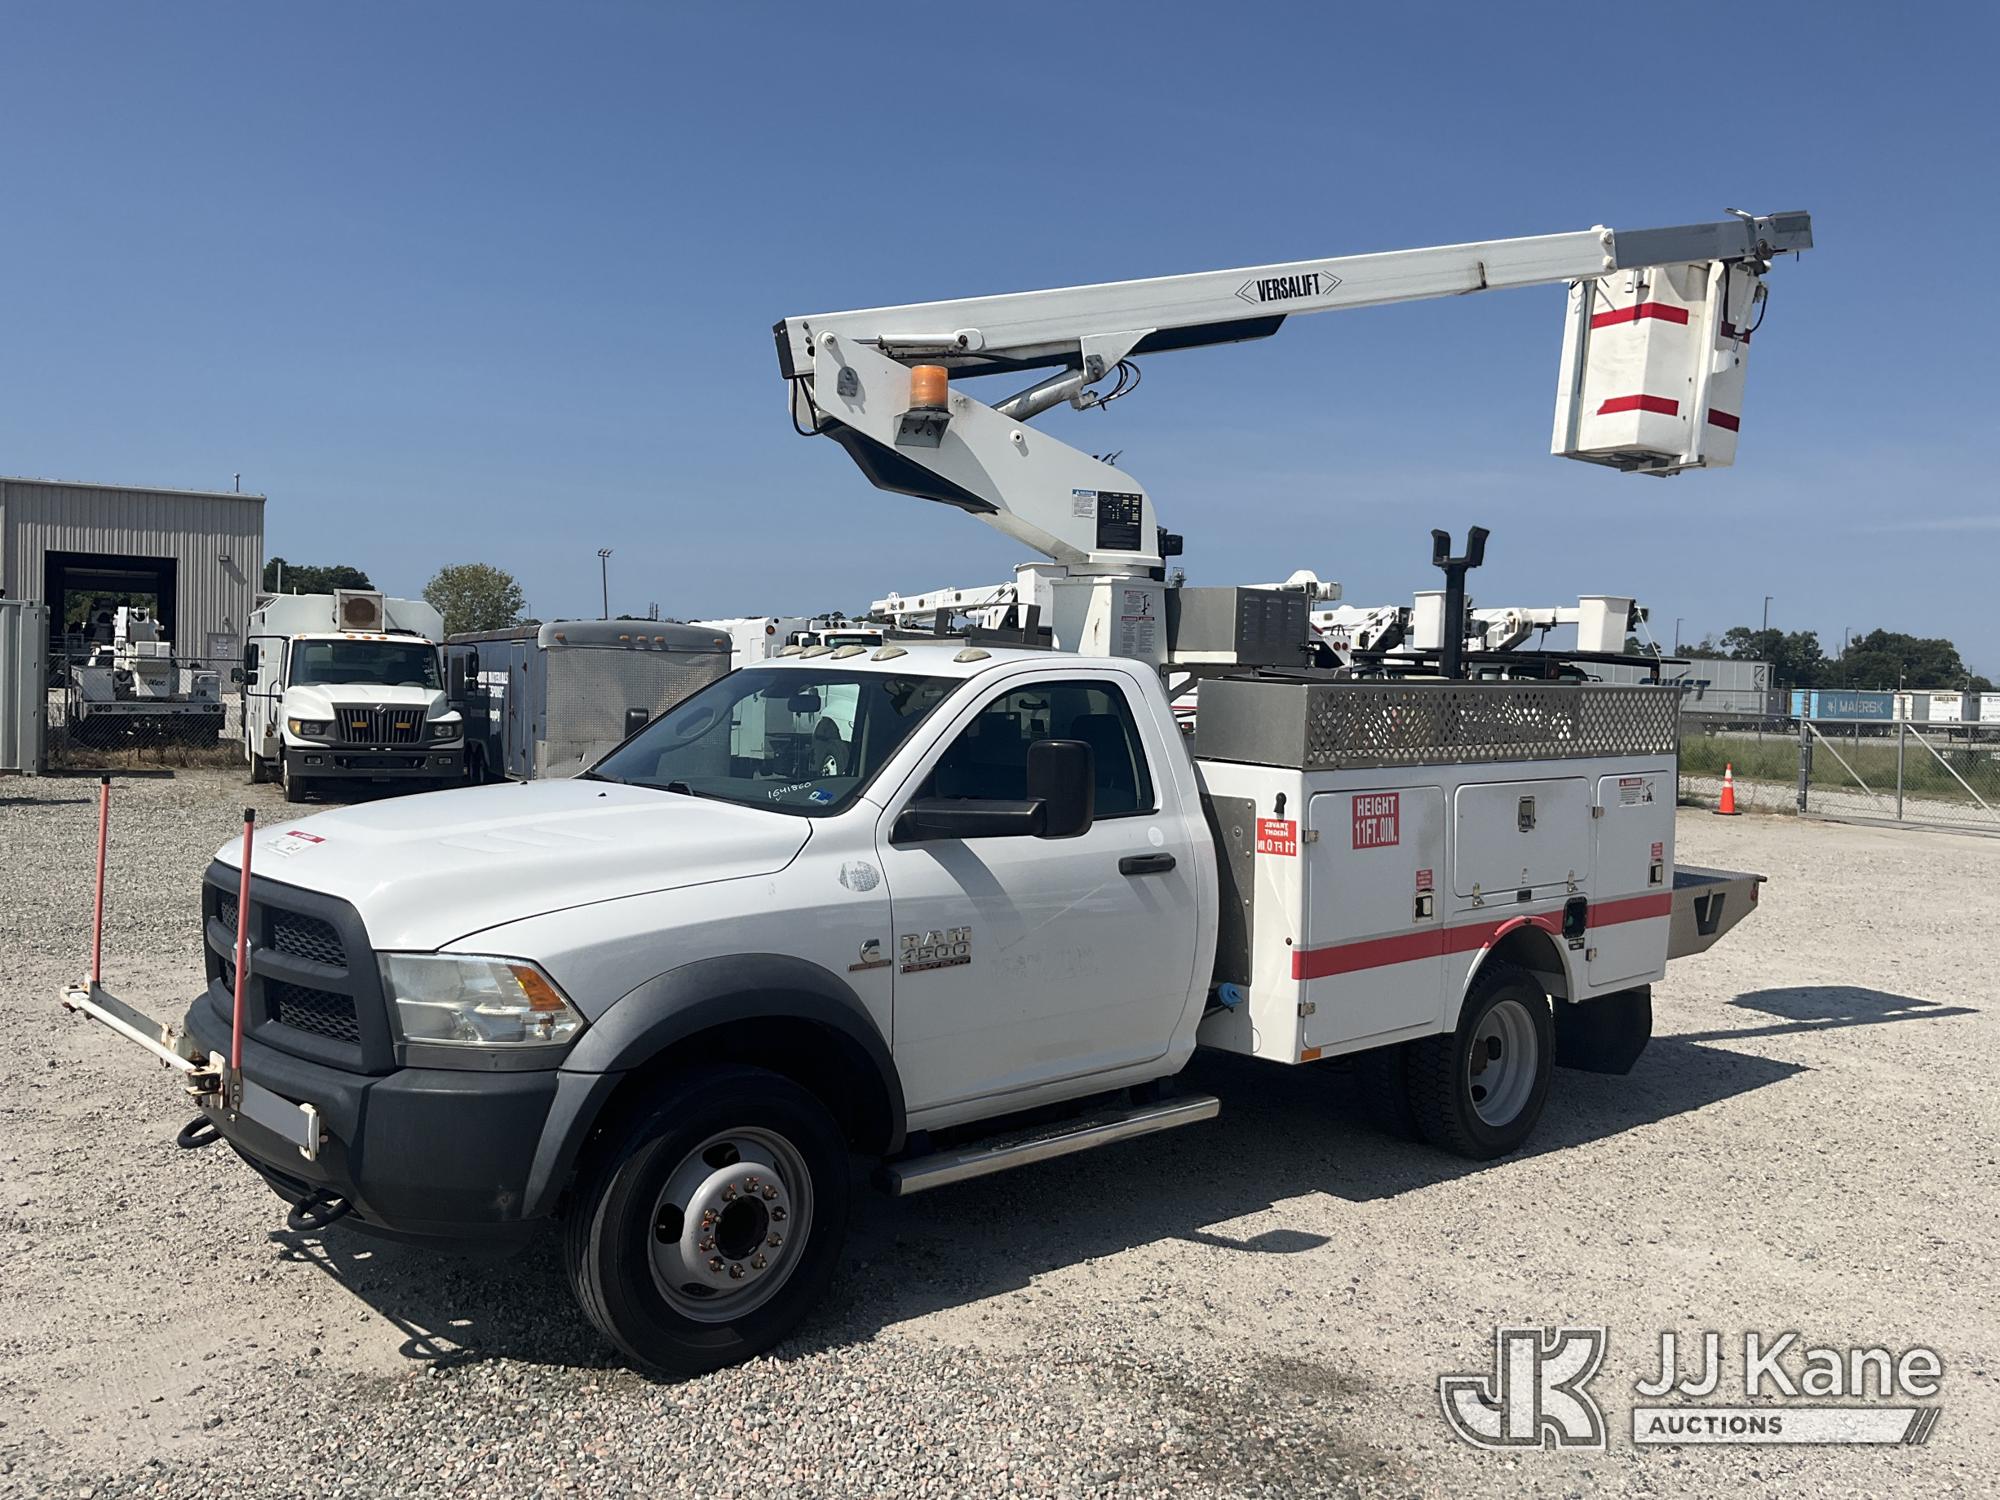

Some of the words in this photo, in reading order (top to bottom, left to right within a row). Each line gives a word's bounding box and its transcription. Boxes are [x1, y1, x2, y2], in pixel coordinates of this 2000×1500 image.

[1256, 273, 1320, 302] VERSALIFT
[1839, 700, 1884, 713] MAERSK
[1356, 796, 1396, 817] HEIGHT
[900, 926, 971, 950] RAM
[900, 941, 970, 962] 4500
